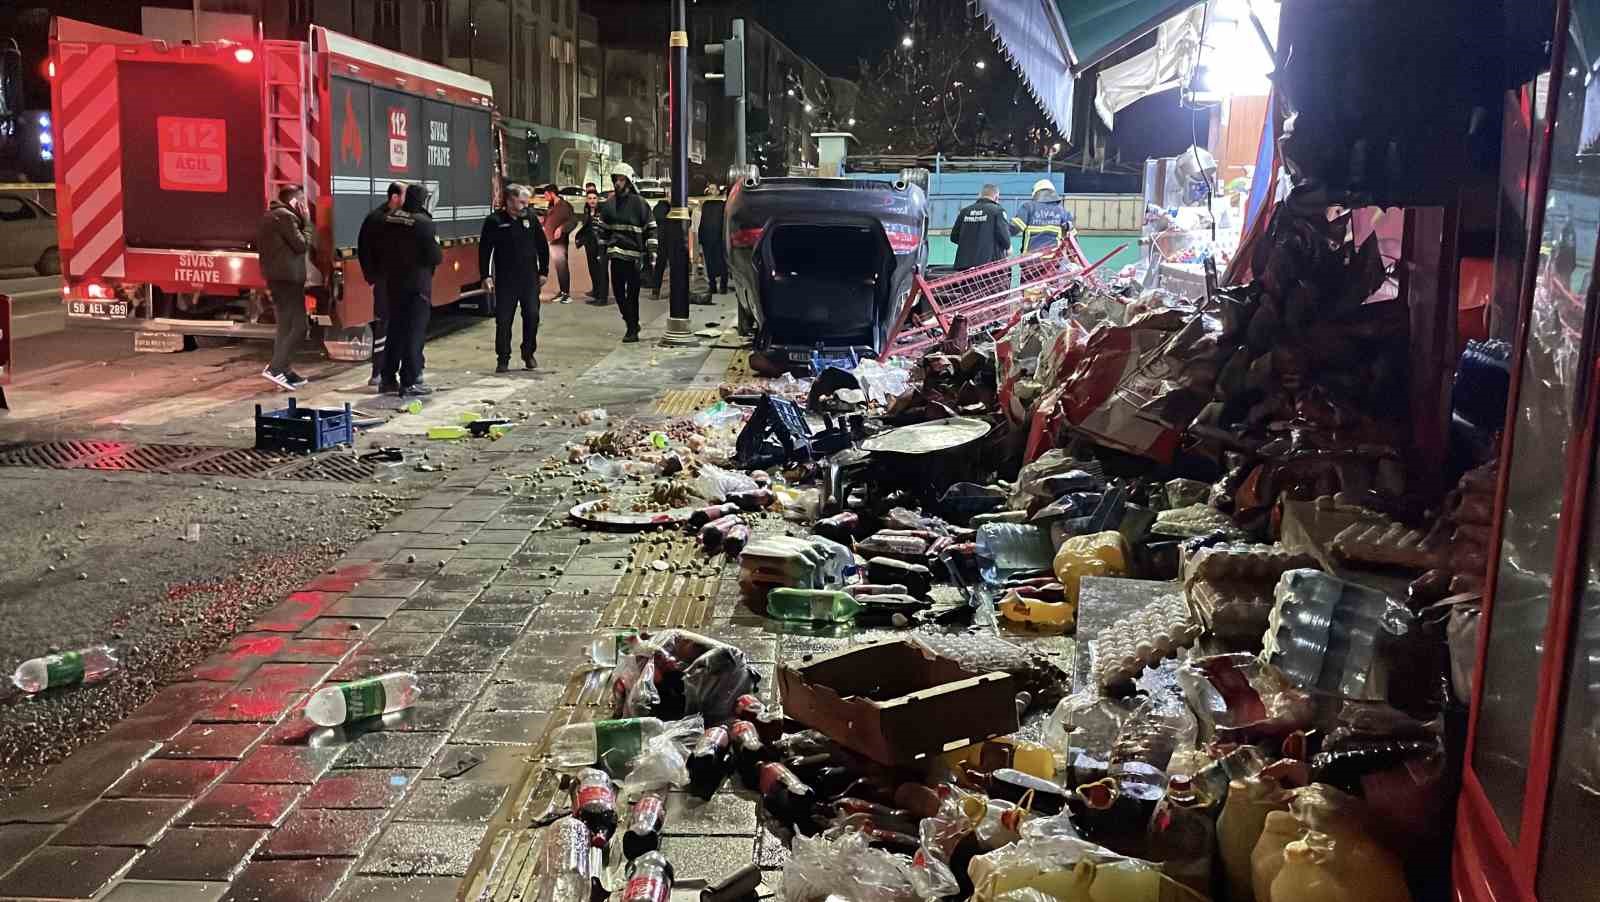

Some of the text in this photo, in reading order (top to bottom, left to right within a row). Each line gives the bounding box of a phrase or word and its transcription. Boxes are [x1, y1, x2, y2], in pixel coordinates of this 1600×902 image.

[167, 121, 219, 149] 112
[391, 111, 407, 137] 112
[73, 302, 126, 315] 58 AEL 289
